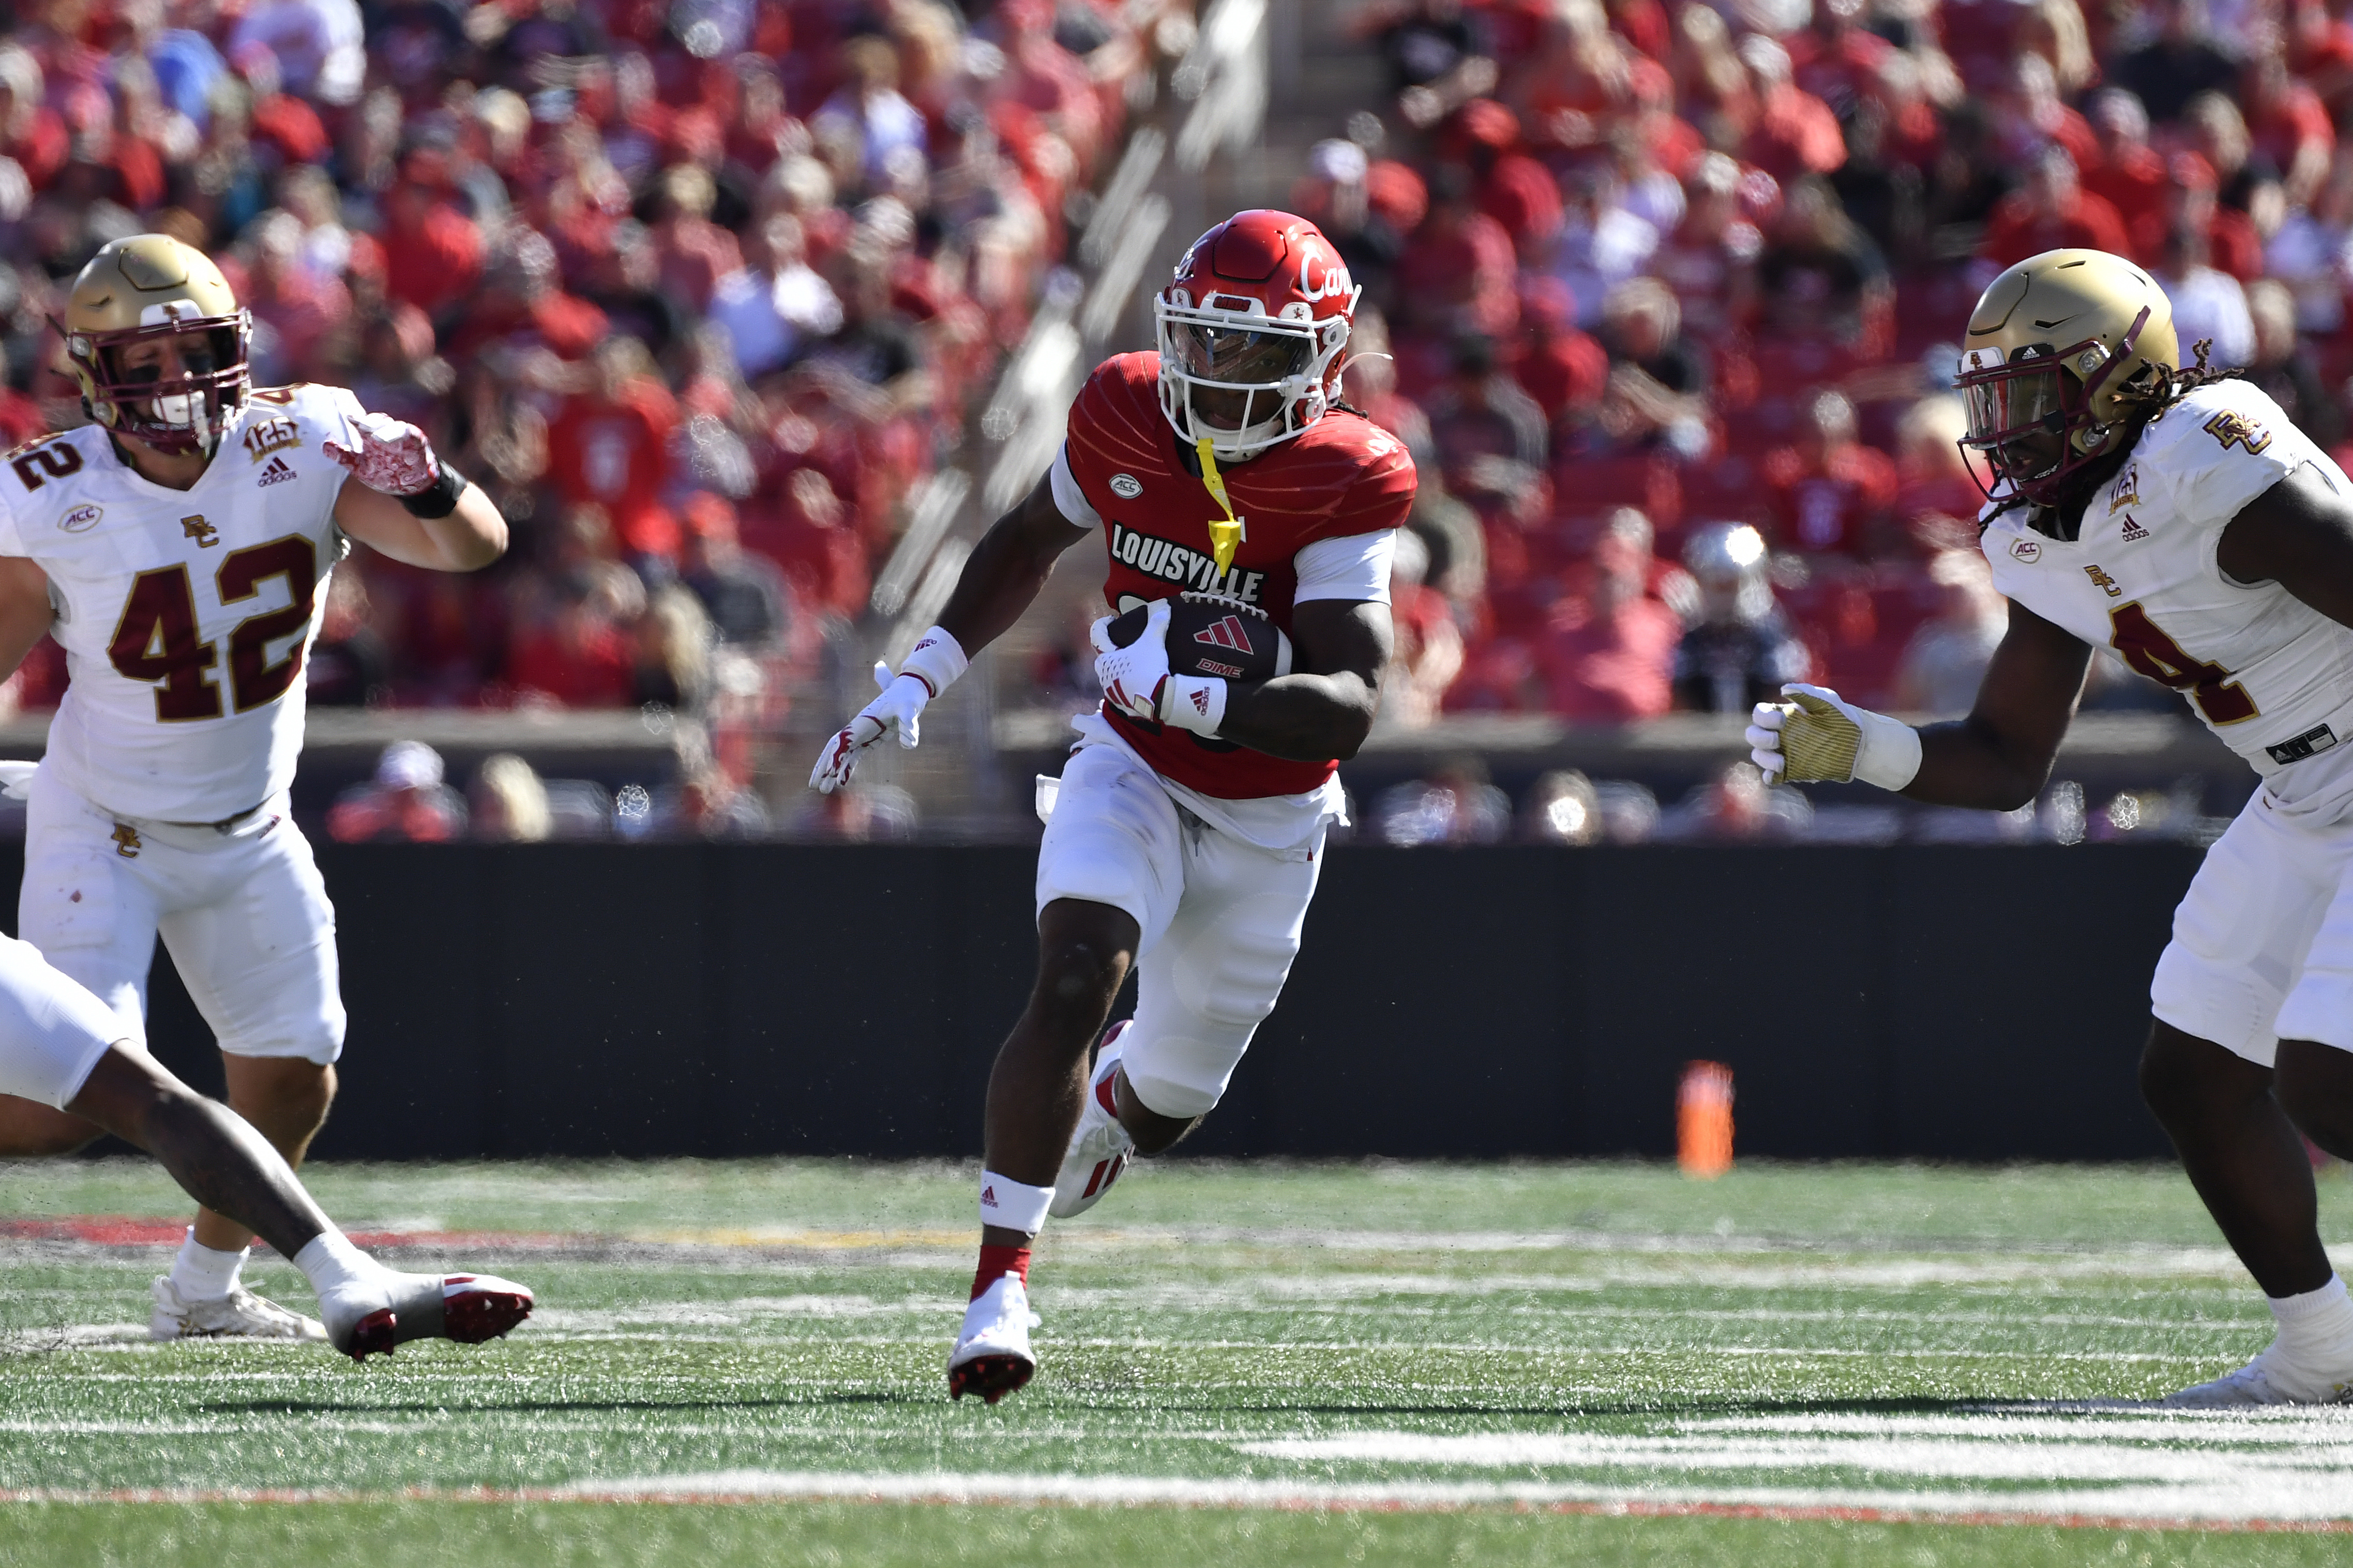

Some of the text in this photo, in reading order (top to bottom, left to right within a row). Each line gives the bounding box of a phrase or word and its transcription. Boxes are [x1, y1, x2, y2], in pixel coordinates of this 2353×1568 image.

[248, 416, 295, 452] 125
[258, 469, 297, 487] adidas
[1113, 480, 1136, 491] ACC
[2114, 494, 2134, 510] SEASONS
[64, 506, 95, 528] ACC
[2122, 528, 2150, 542] adidas
[2016, 542, 2036, 554] ACC
[1112, 524, 1264, 602] LOUISVILLE
[106, 532, 316, 723] 42
[1196, 658, 1244, 678] DIME
[2109, 600, 2260, 726] 4
[1200, 686, 1210, 716] adidas
